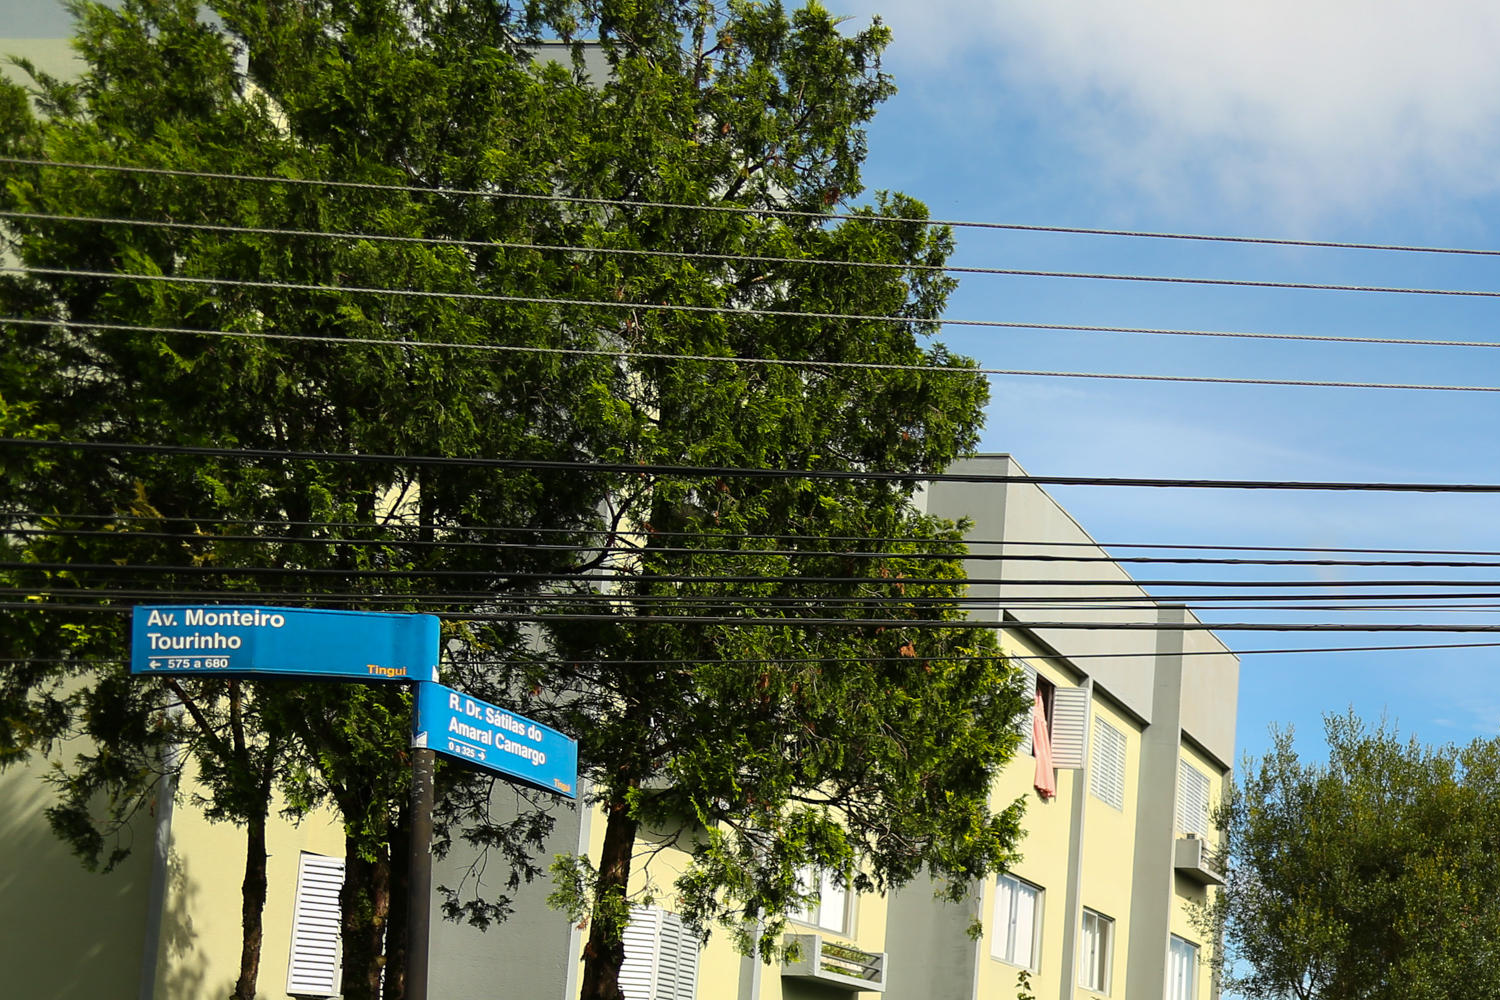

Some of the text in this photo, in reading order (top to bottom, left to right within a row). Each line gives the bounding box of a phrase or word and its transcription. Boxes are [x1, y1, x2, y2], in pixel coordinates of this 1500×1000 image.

[147, 609, 285, 628] Av. Monteiro
[147, 632, 242, 650] Tourinho
[167, 658, 229, 669] 575 a 680
[366, 664, 407, 678] Tingui
[449, 693, 543, 742] R. Dr. Sátilas do
[448, 716, 546, 766] Amaral Camargo
[448, 741, 476, 759] 0 a 325
